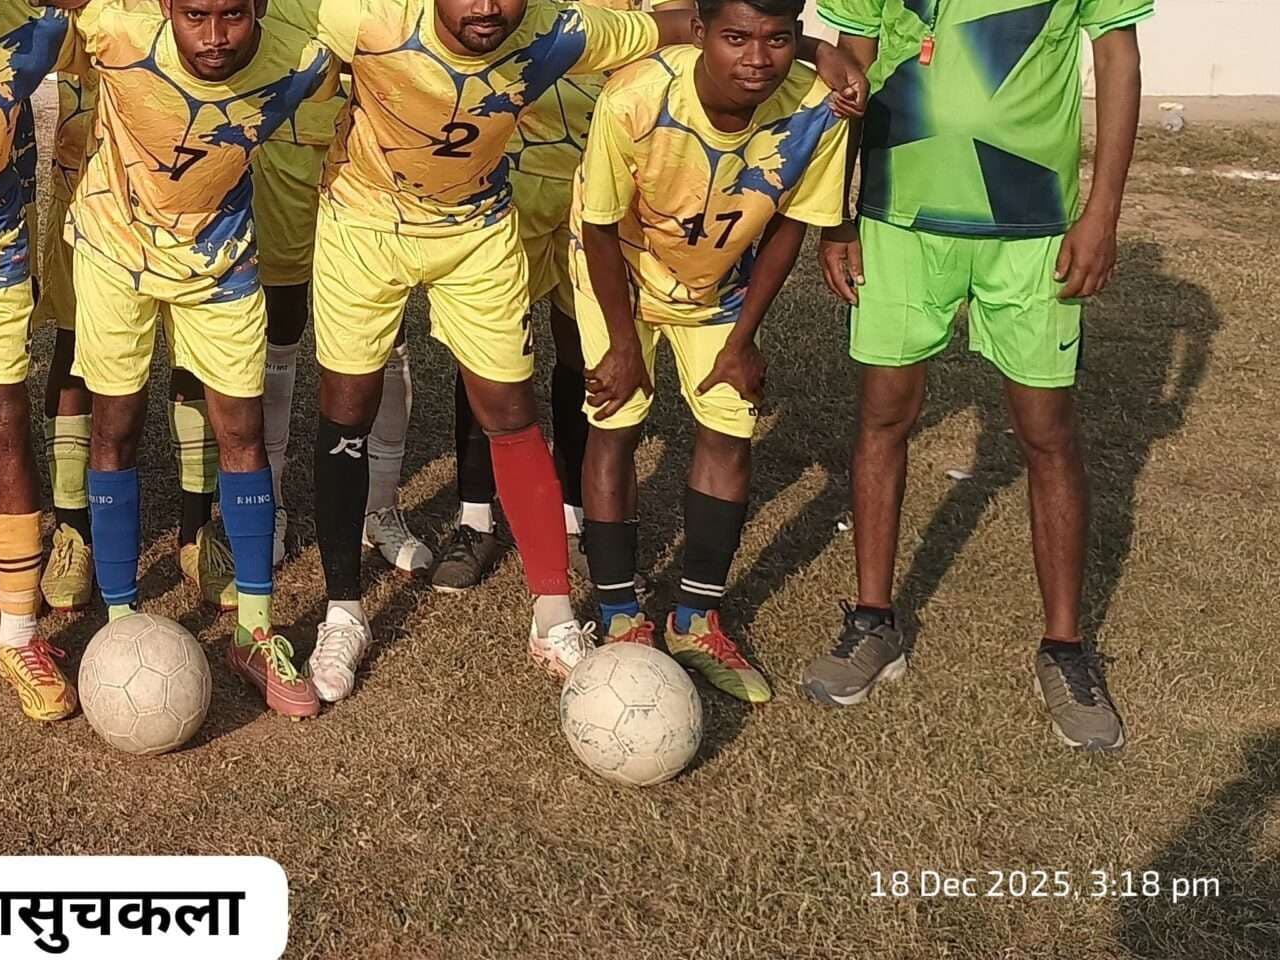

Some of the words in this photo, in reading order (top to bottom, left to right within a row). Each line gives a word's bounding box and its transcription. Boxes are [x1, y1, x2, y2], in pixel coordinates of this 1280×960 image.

[431, 121, 480, 158] 2
[169, 145, 209, 181] 7
[236, 493, 271, 505] RHINO
